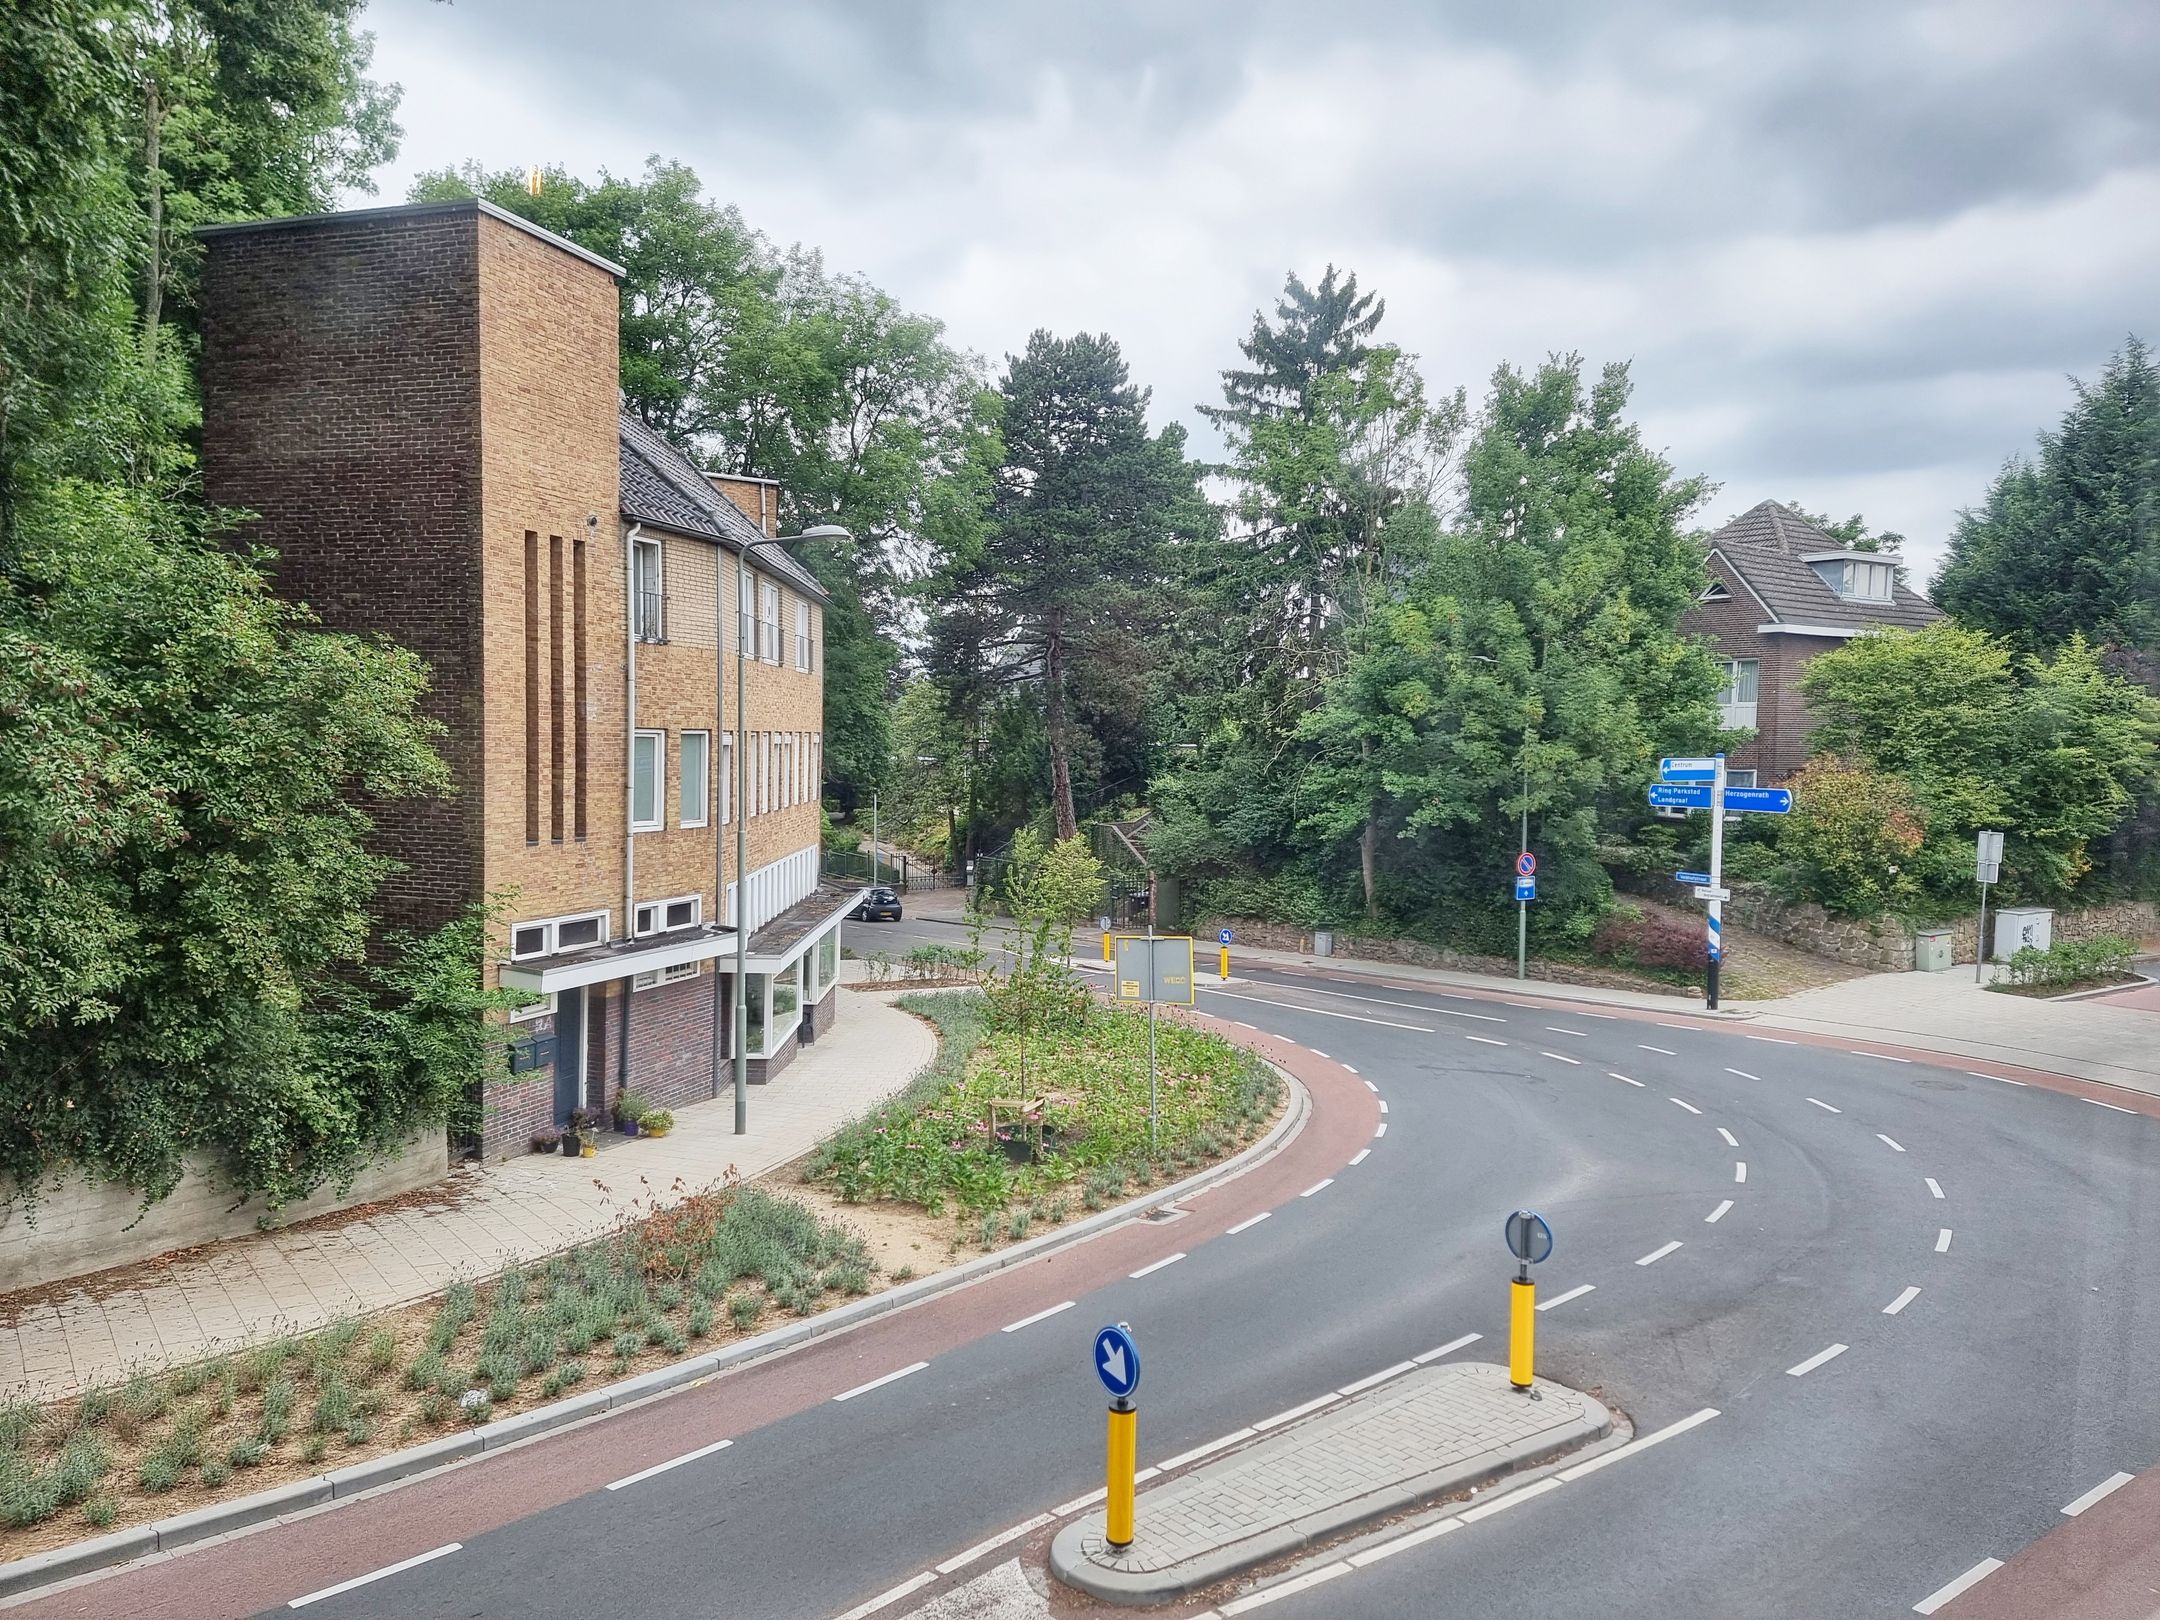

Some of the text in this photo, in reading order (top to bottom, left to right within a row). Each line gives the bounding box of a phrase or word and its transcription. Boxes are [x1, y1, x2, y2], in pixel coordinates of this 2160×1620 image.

[1658, 787, 1671, 795] Ring
[1725, 790, 1769, 799] Herzogenrath
[1657, 796, 1688, 804] Landgraaf
